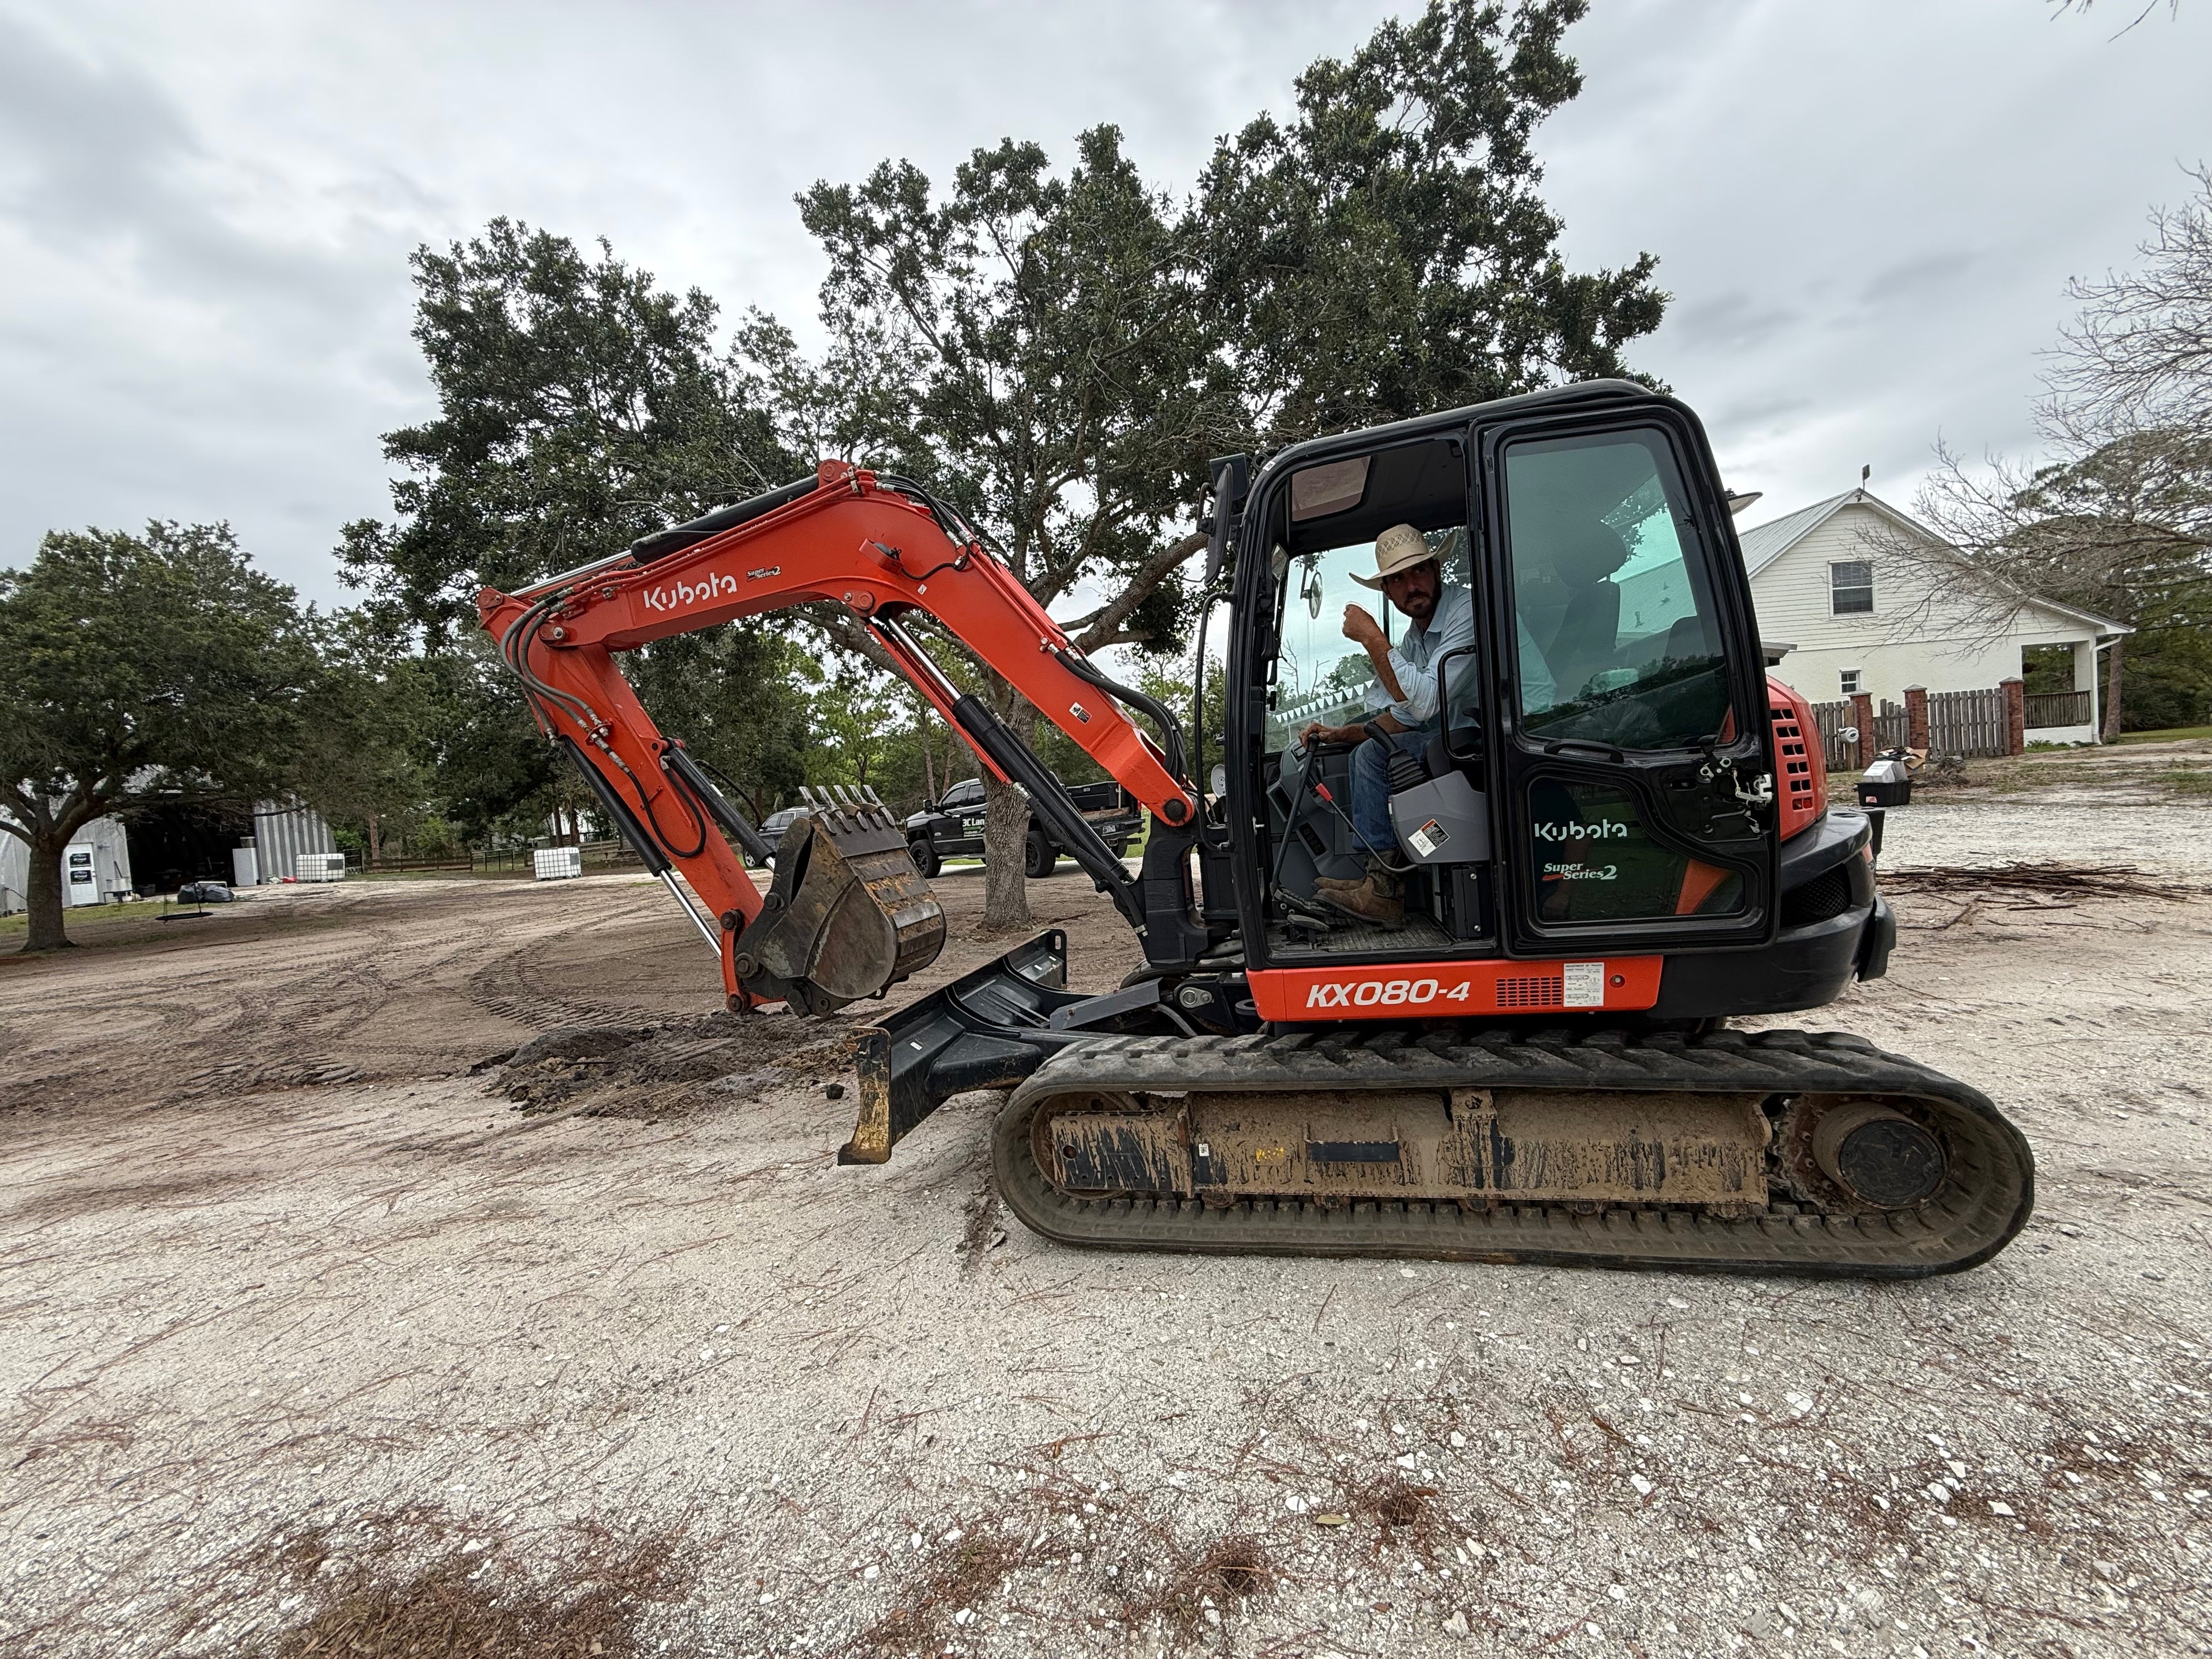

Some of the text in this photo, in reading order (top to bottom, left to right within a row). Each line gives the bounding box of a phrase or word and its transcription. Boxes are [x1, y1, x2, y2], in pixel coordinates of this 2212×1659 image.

[747, 568, 765, 577] Super
[643, 572, 738, 611] Kubota
[962, 818, 971, 827] 3C
[1535, 819, 1627, 841] Kubota
[1543, 862, 1584, 874] Super
[1306, 979, 1471, 1007] KX080-4
